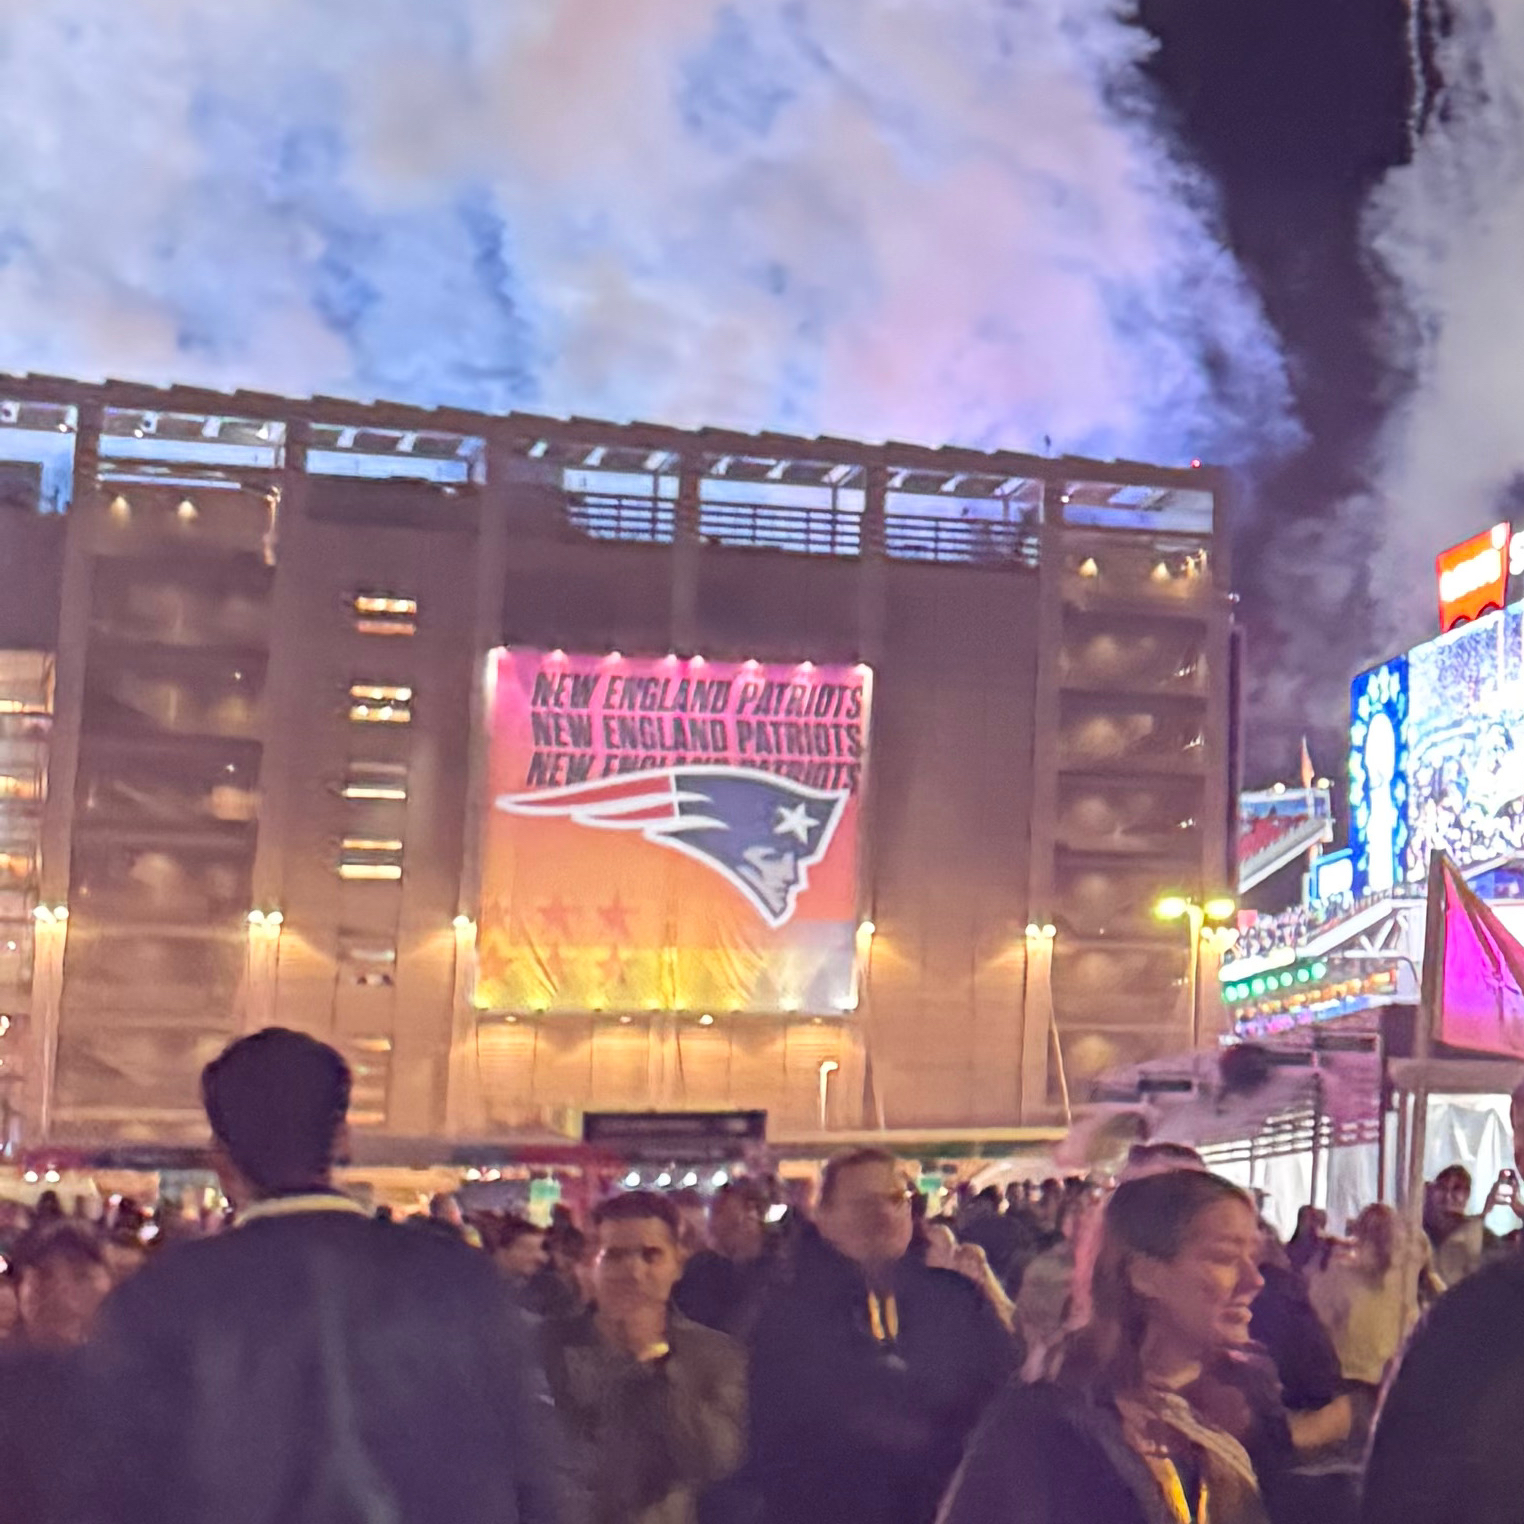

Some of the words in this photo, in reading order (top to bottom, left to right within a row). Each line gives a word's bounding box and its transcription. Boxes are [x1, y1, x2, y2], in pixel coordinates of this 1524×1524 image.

[532, 672, 601, 708] NEW
[602, 675, 731, 713] ENGLAND
[736, 681, 863, 718] PATRIOTS
[531, 711, 592, 747] NEW
[602, 714, 728, 752] ENGLAND
[736, 719, 861, 757] PATRIOTS
[526, 751, 596, 787] NEW
